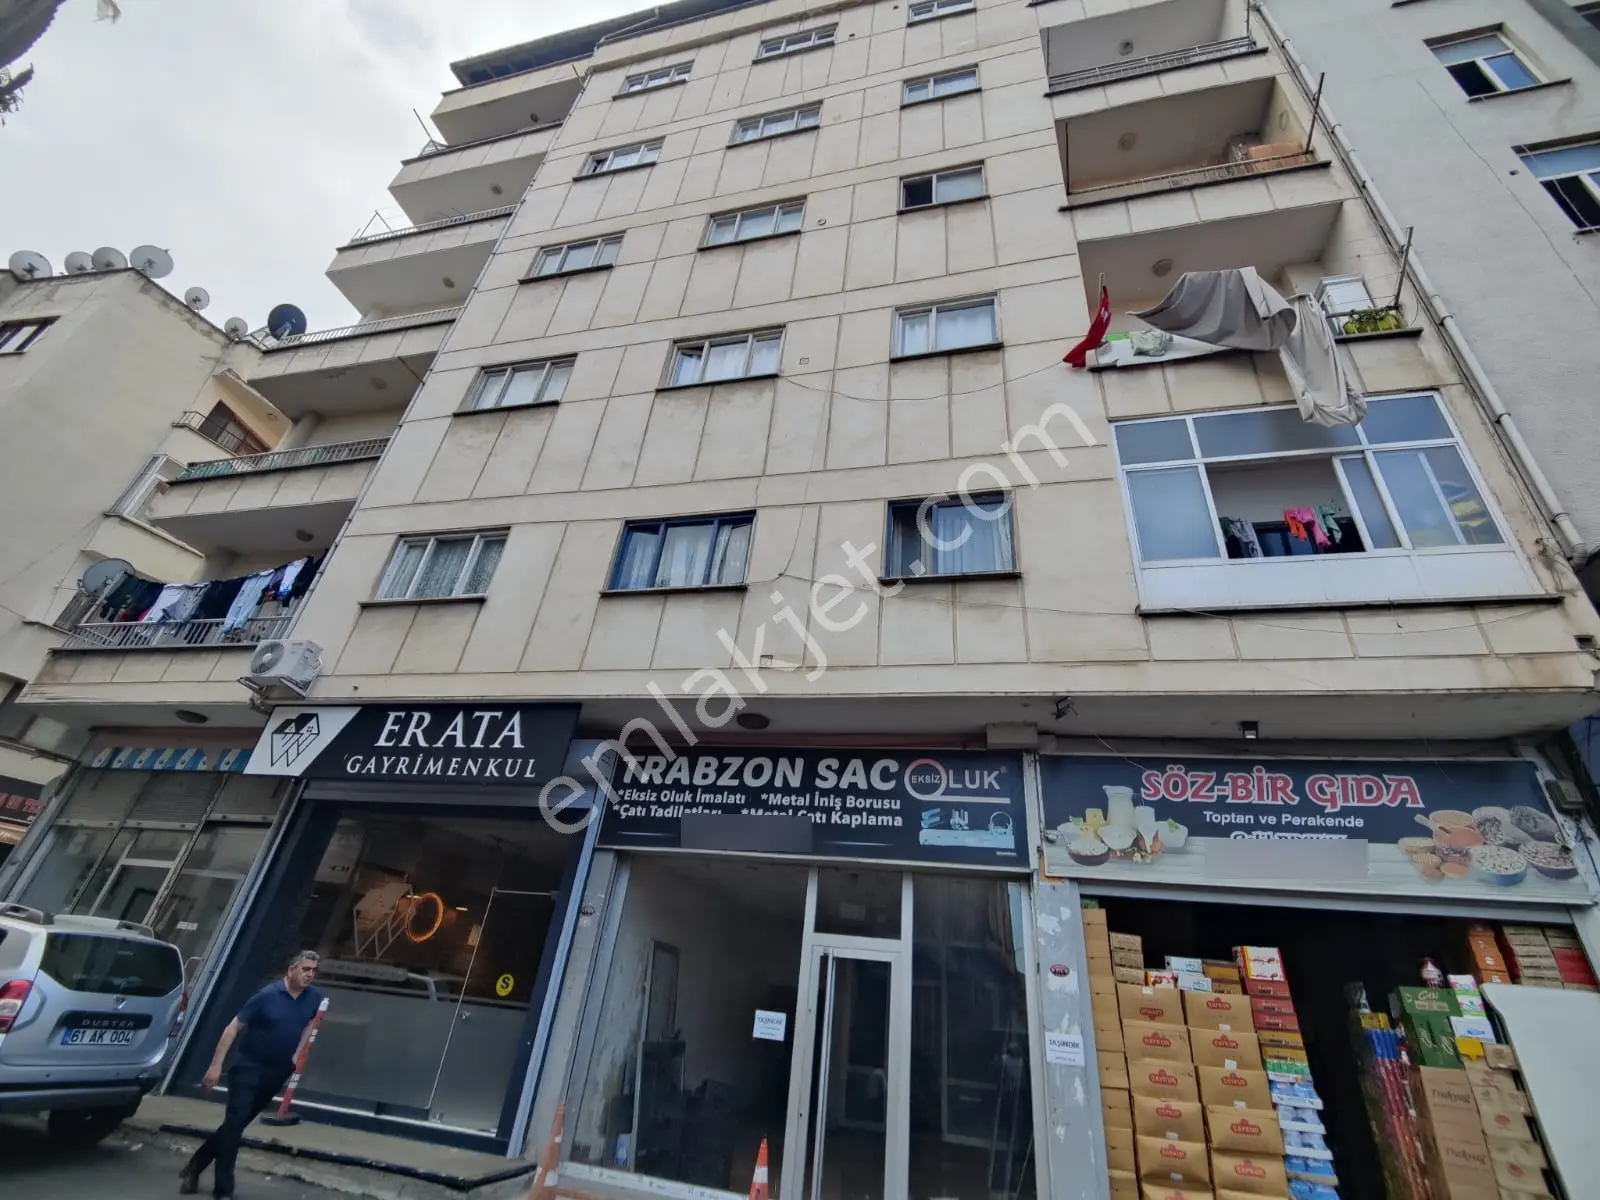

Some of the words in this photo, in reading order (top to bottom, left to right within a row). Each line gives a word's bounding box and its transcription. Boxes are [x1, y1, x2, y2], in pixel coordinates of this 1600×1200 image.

[374, 710, 525, 749] ERATA
[346, 753, 537, 778] GAYRİMENKUL
[621, 754, 805, 790] TRABZON
[815, 758, 899, 791] SAC
[911, 773, 941, 784] EKSİZ
[660, 789, 693, 803] Oluk
[695, 787, 746, 804] İmalatı
[814, 791, 842, 810] İniş
[845, 795, 901, 810] Borusu
[1141, 765, 1299, 806] SÖZ-BİR
[1305, 772, 1425, 813] GIDA
[831, 811, 904, 828] Kaplama
[1203, 810, 1254, 825] Toptan
[1259, 814, 1277, 825] ve
[1281, 813, 1364, 828] Perakende
[81, 1019, 135, 1028] DUSTER
[71, 1029, 87, 1043] 61
[88, 1030, 107, 1043] AK
[109, 1031, 133, 1044] 004
